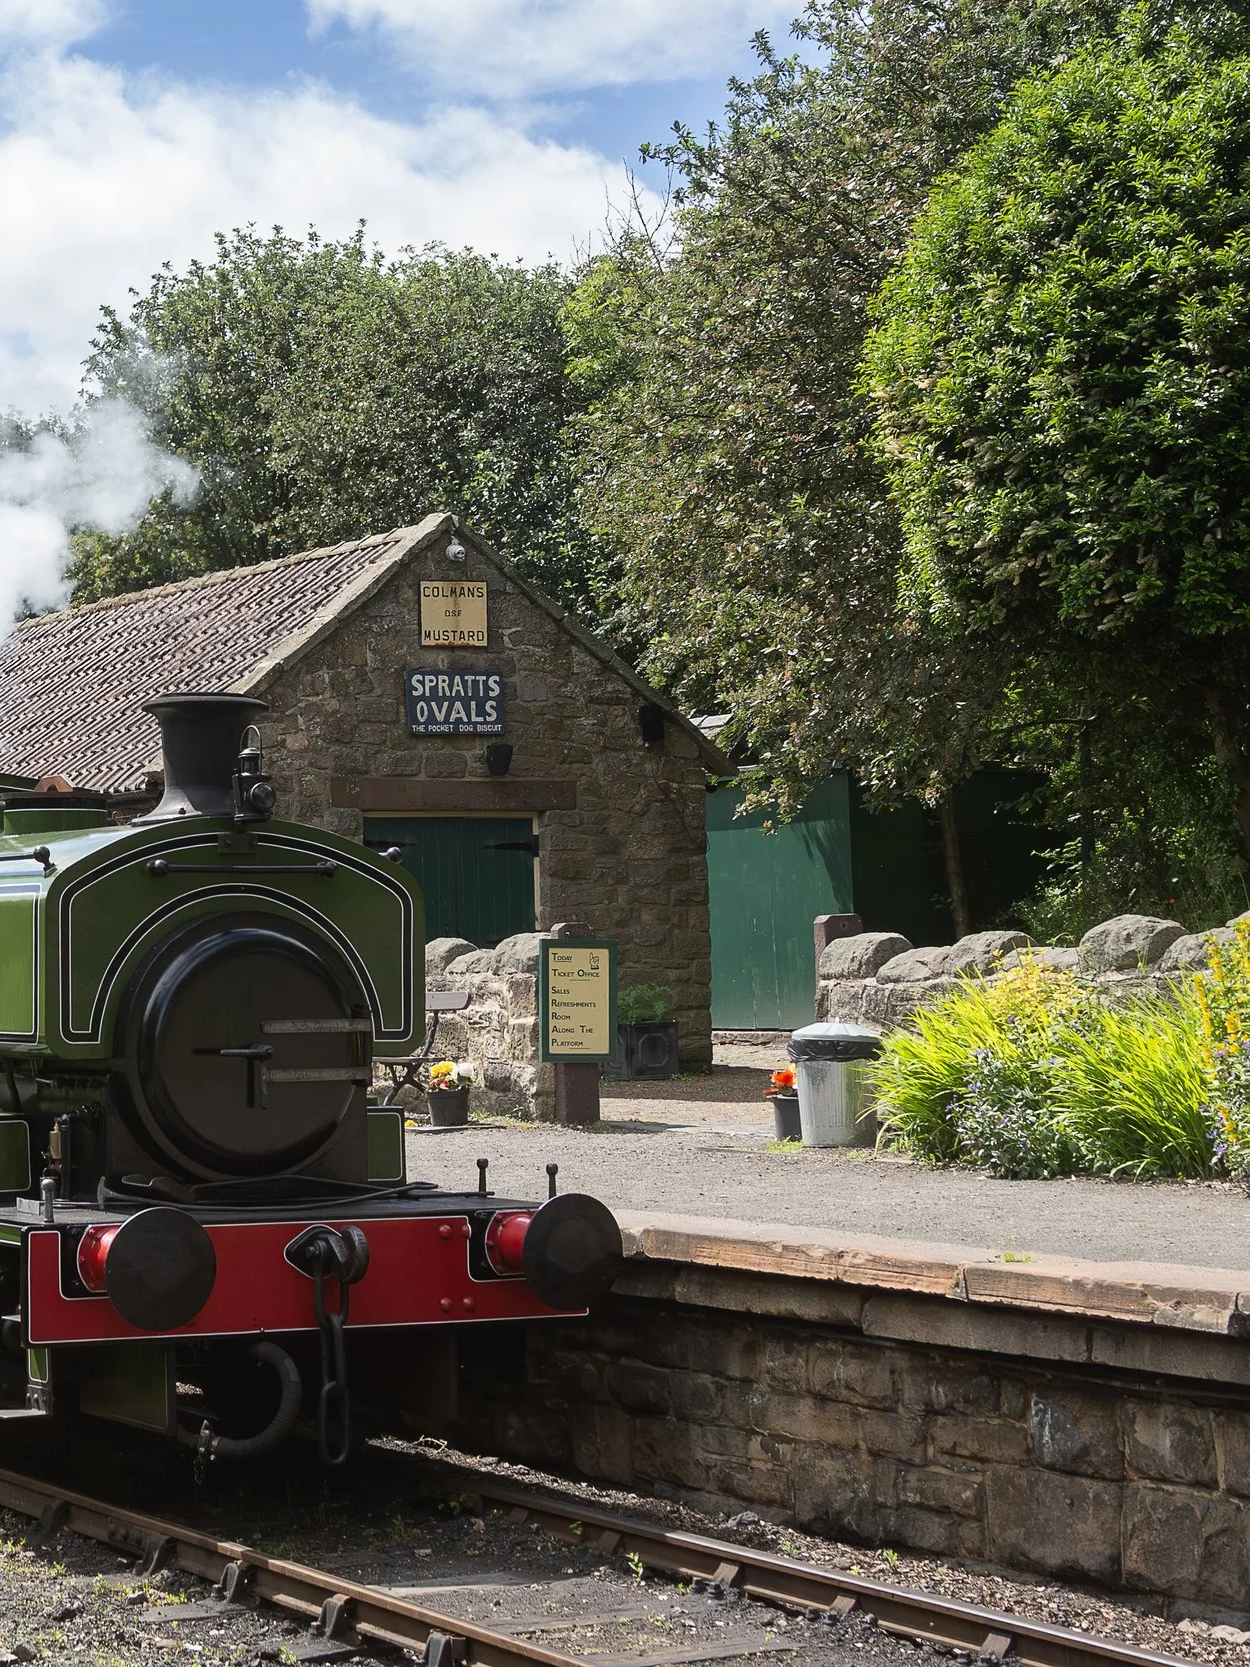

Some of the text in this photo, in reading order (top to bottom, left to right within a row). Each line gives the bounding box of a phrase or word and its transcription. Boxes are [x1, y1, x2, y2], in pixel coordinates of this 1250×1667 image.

[424, 629, 485, 642] MUSTARD
[411, 674, 501, 697] SPRATTS
[416, 700, 498, 723] OVALS
[411, 724, 503, 733] THE POCKET DOG BISCUIT
[551, 952, 573, 961] TODAY
[552, 968, 600, 978] TICKET OFFICE
[551, 985, 570, 995] SALES
[551, 998, 597, 1008] REFRESHMENTS
[551, 1011, 571, 1021] ROOM
[551, 1025, 594, 1034] ALONG THE
[551, 1038, 584, 1047] PLATFORM
